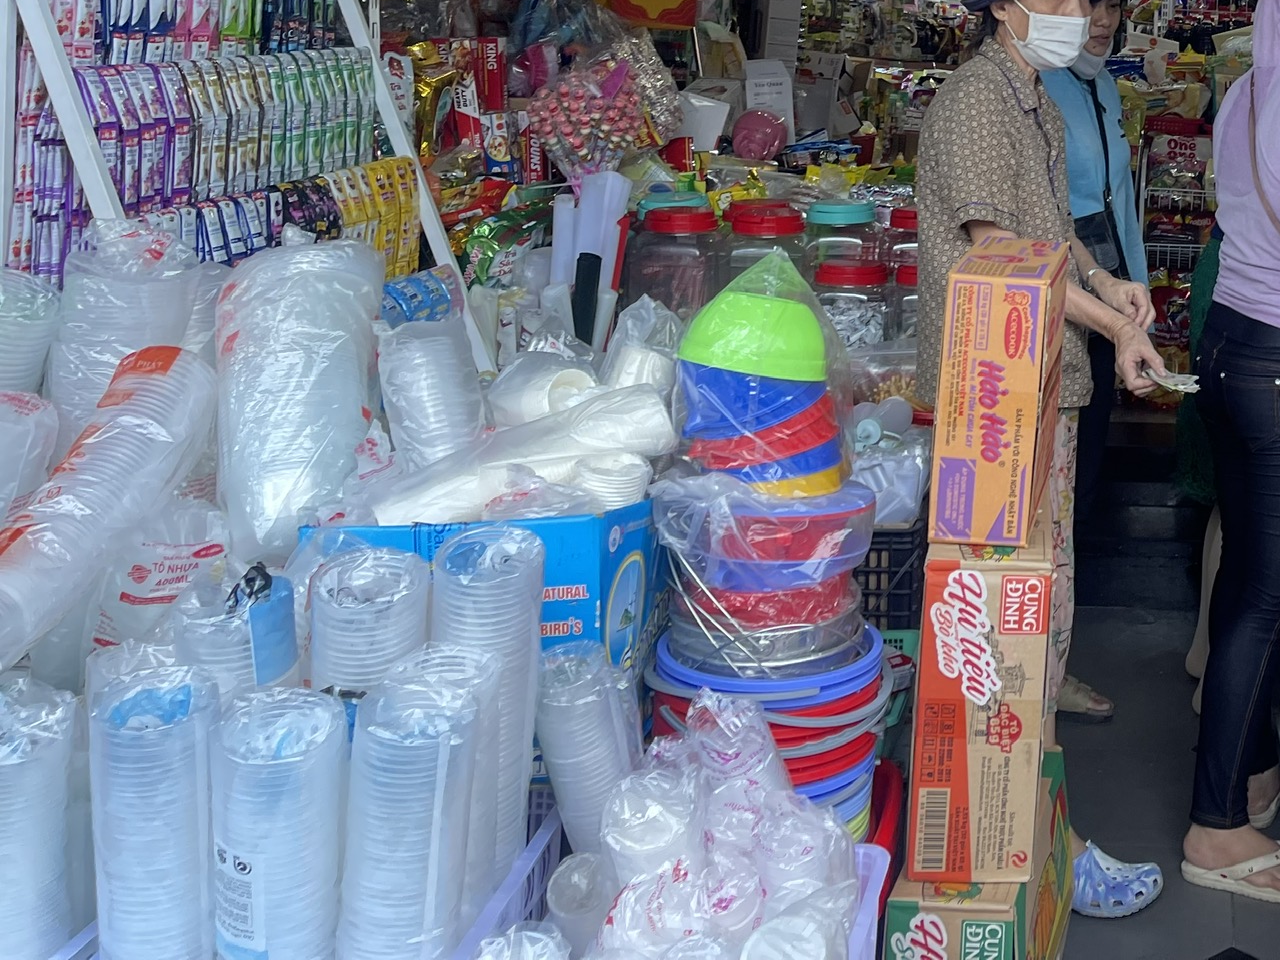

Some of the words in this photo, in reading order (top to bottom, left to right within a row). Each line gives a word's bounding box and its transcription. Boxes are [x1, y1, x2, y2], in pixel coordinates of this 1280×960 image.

[438, 43, 449, 63] KIN
[486, 43, 497, 70] KING
[1167, 138, 1197, 151] One
[961, 350, 969, 382] ACECOOK
[977, 360, 1010, 410] Hảo
[1015, 408, 1025, 423] SẢN
[980, 412, 1012, 463] Hảo
[1010, 458, 1020, 478] CÔNG
[1008, 479, 1018, 498] NGHỆ
[1006, 520, 1016, 534] BẢN
[152, 561, 165, 574] TÔ
[154, 574, 191, 587] 400ML
[542, 585, 589, 600] ATURAL
[1004, 581, 1024, 629] ĐÌNH
[1022, 579, 1042, 631] CUNG
[540, 617, 583, 636] BIRD'S
[935, 608, 954, 637] Bò
[941, 640, 959, 674] kho
[960, 637, 997, 698] tiếu
[1009, 719, 1020, 733] TÔ
[1000, 728, 1012, 753] BIỆT
